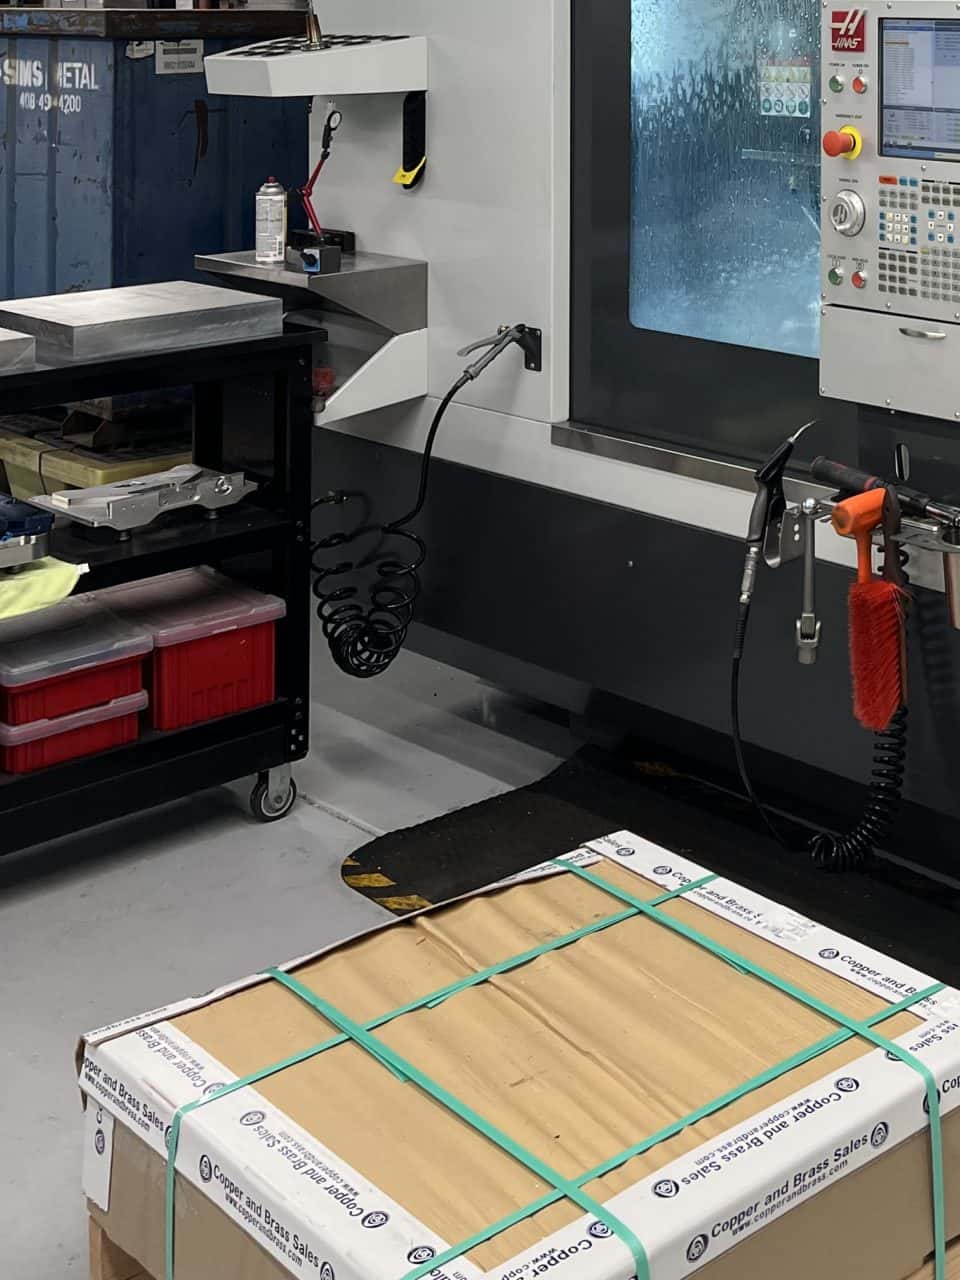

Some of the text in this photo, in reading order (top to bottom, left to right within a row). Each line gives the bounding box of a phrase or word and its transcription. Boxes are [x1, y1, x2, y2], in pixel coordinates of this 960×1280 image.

[3, 59, 43, 87] SIMS
[706, 889, 728, 900] and
[841, 954, 882, 978] Copper
[881, 976, 906, 990] and
[155, 1046, 177, 1062] and
[909, 1033, 943, 1052] Sales
[173, 1060, 207, 1088] Copper
[84, 1057, 164, 1132] pper and Brass Sales
[681, 1092, 842, 1186] Copper and Brass Sales
[253, 1124, 365, 1217] Copper and Brass Sales
[711, 1133, 869, 1238] Copper and Brass Sales
[213, 1164, 319, 1269] Copper and Brass Sales
[532, 1239, 593, 1278] Copper
